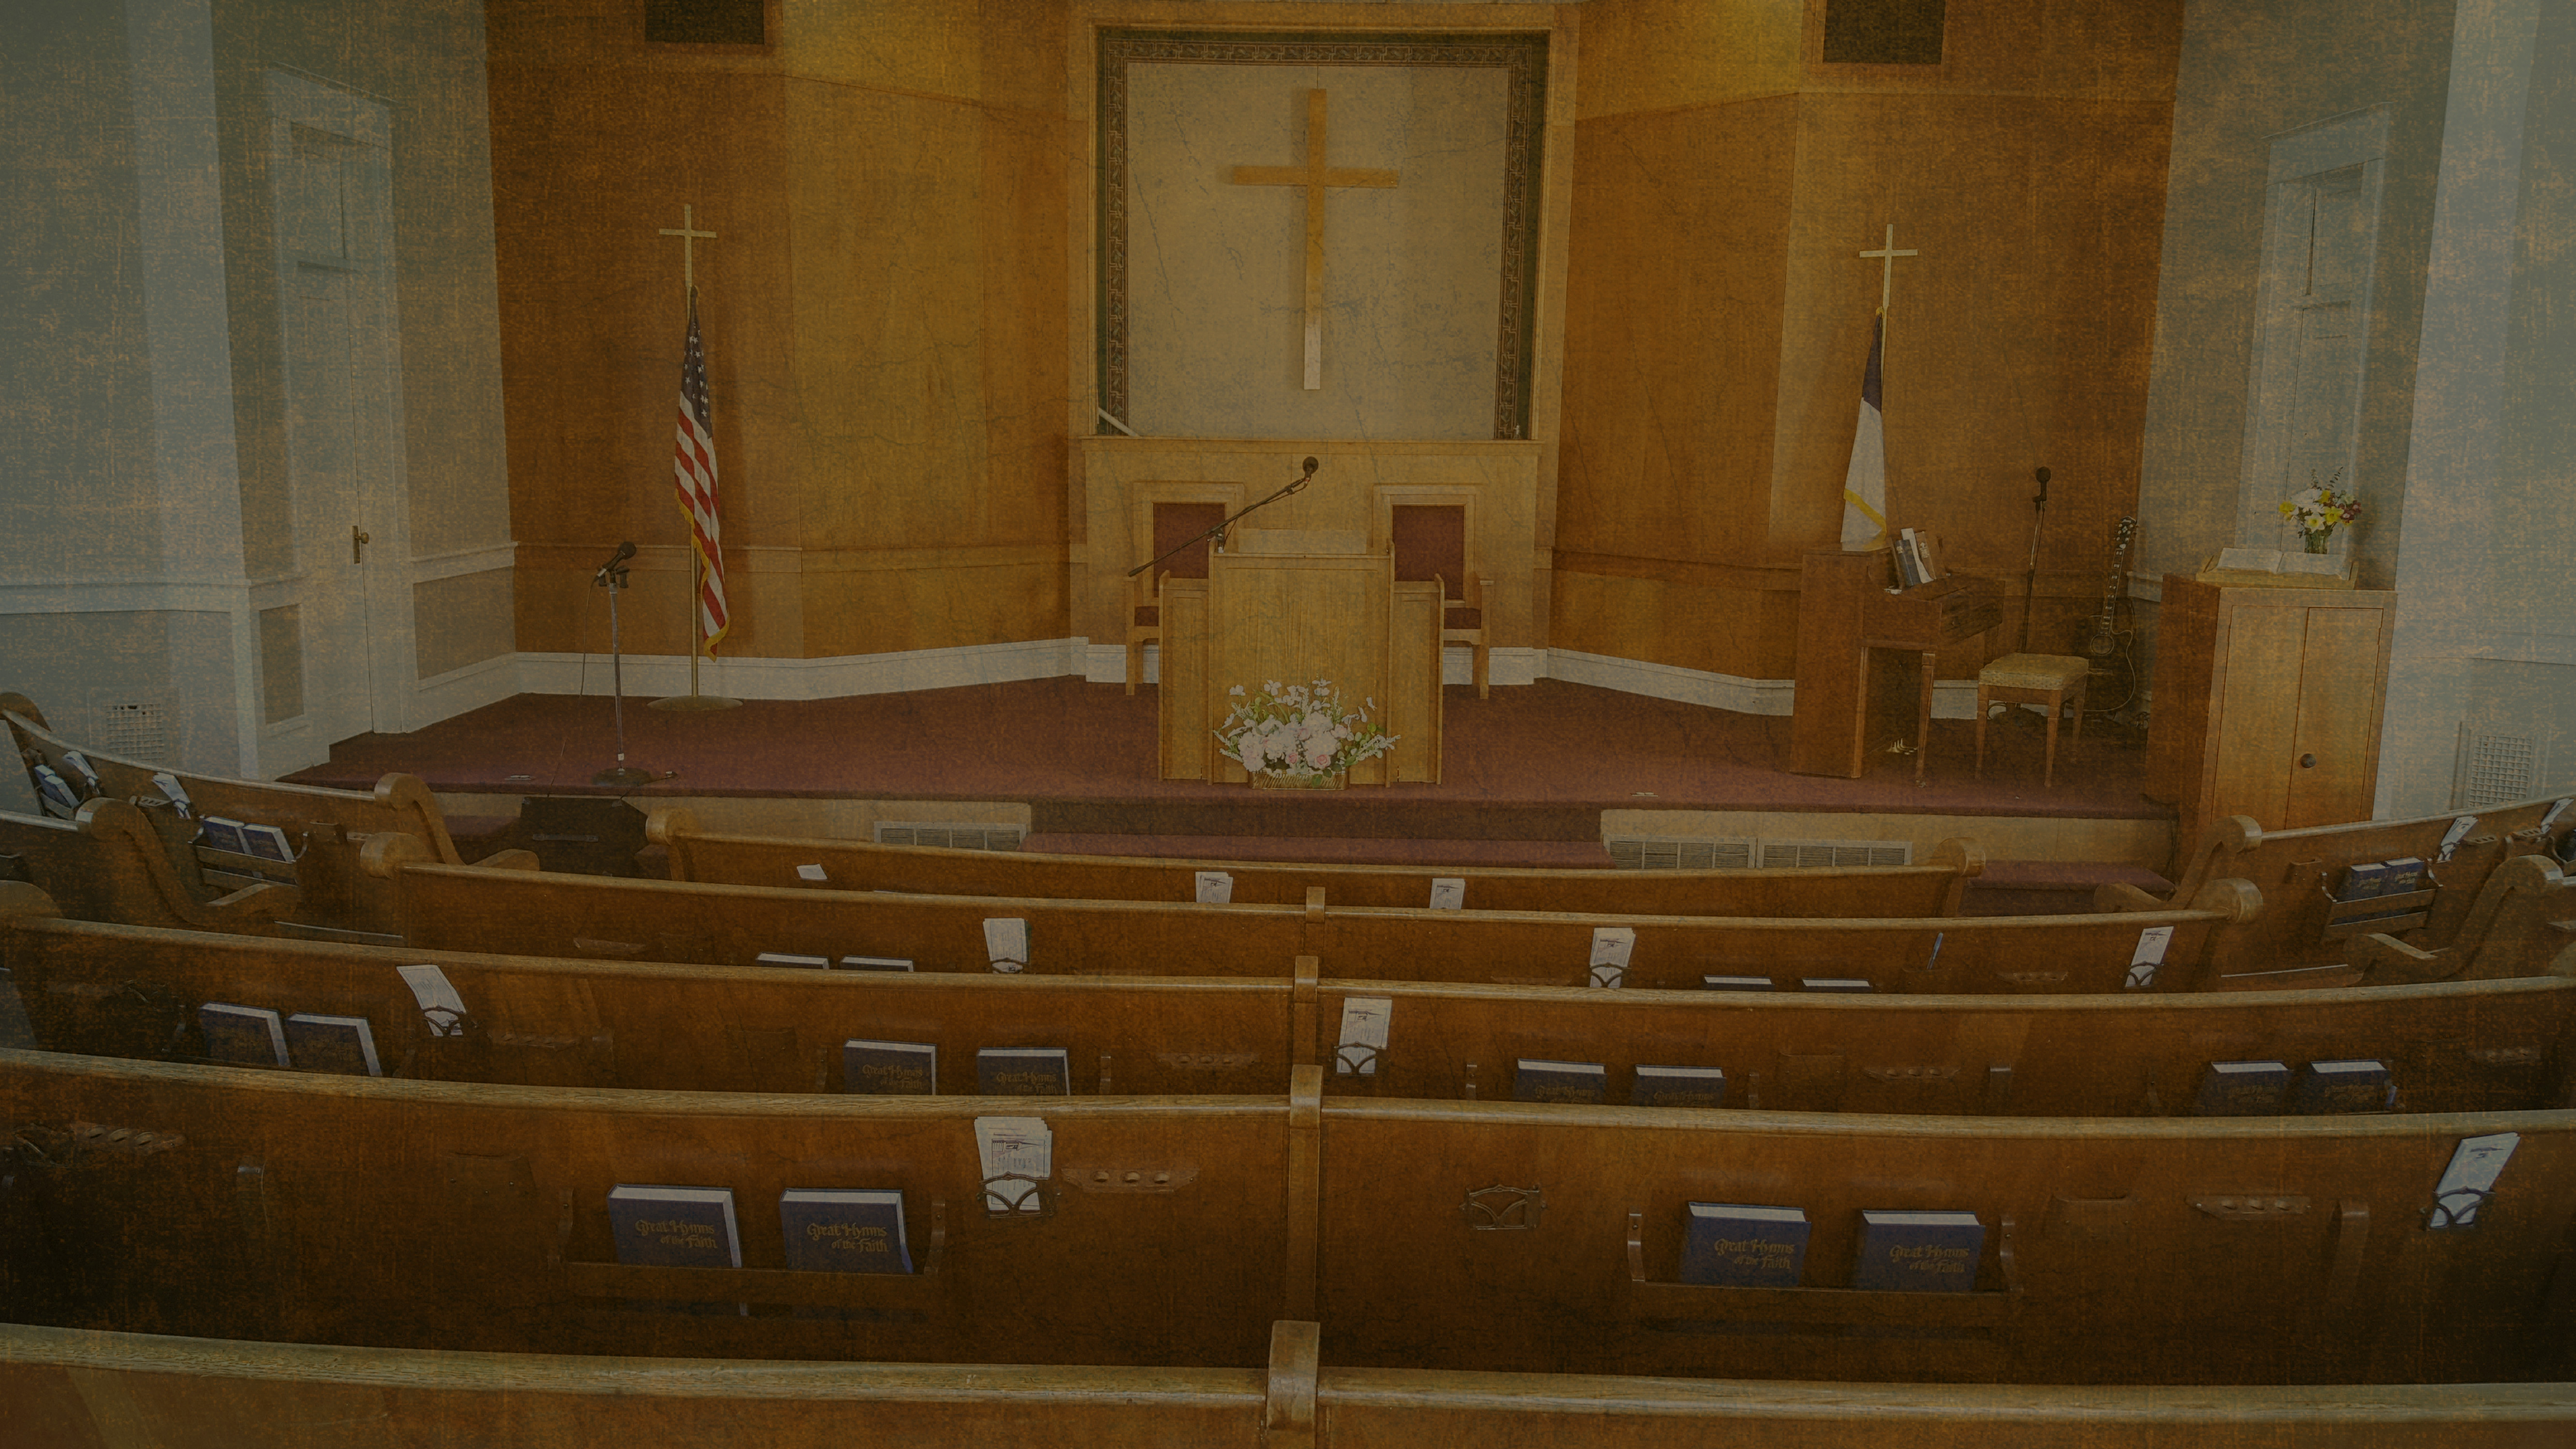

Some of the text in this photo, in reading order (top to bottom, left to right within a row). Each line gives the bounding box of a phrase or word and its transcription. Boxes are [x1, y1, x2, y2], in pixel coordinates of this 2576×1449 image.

[635, 1219, 715, 1236] Great Hymns
[806, 1222, 887, 1241] Great Hymns
[660, 1235, 671, 1244] of
[685, 1234, 718, 1249] Faith
[831, 1238, 890, 1253] of the Faith
[1714, 1238, 1795, 1256] Great Hymns
[1760, 1254, 1792, 1269] Faith
[1889, 1244, 1970, 1263] Great Hymns
